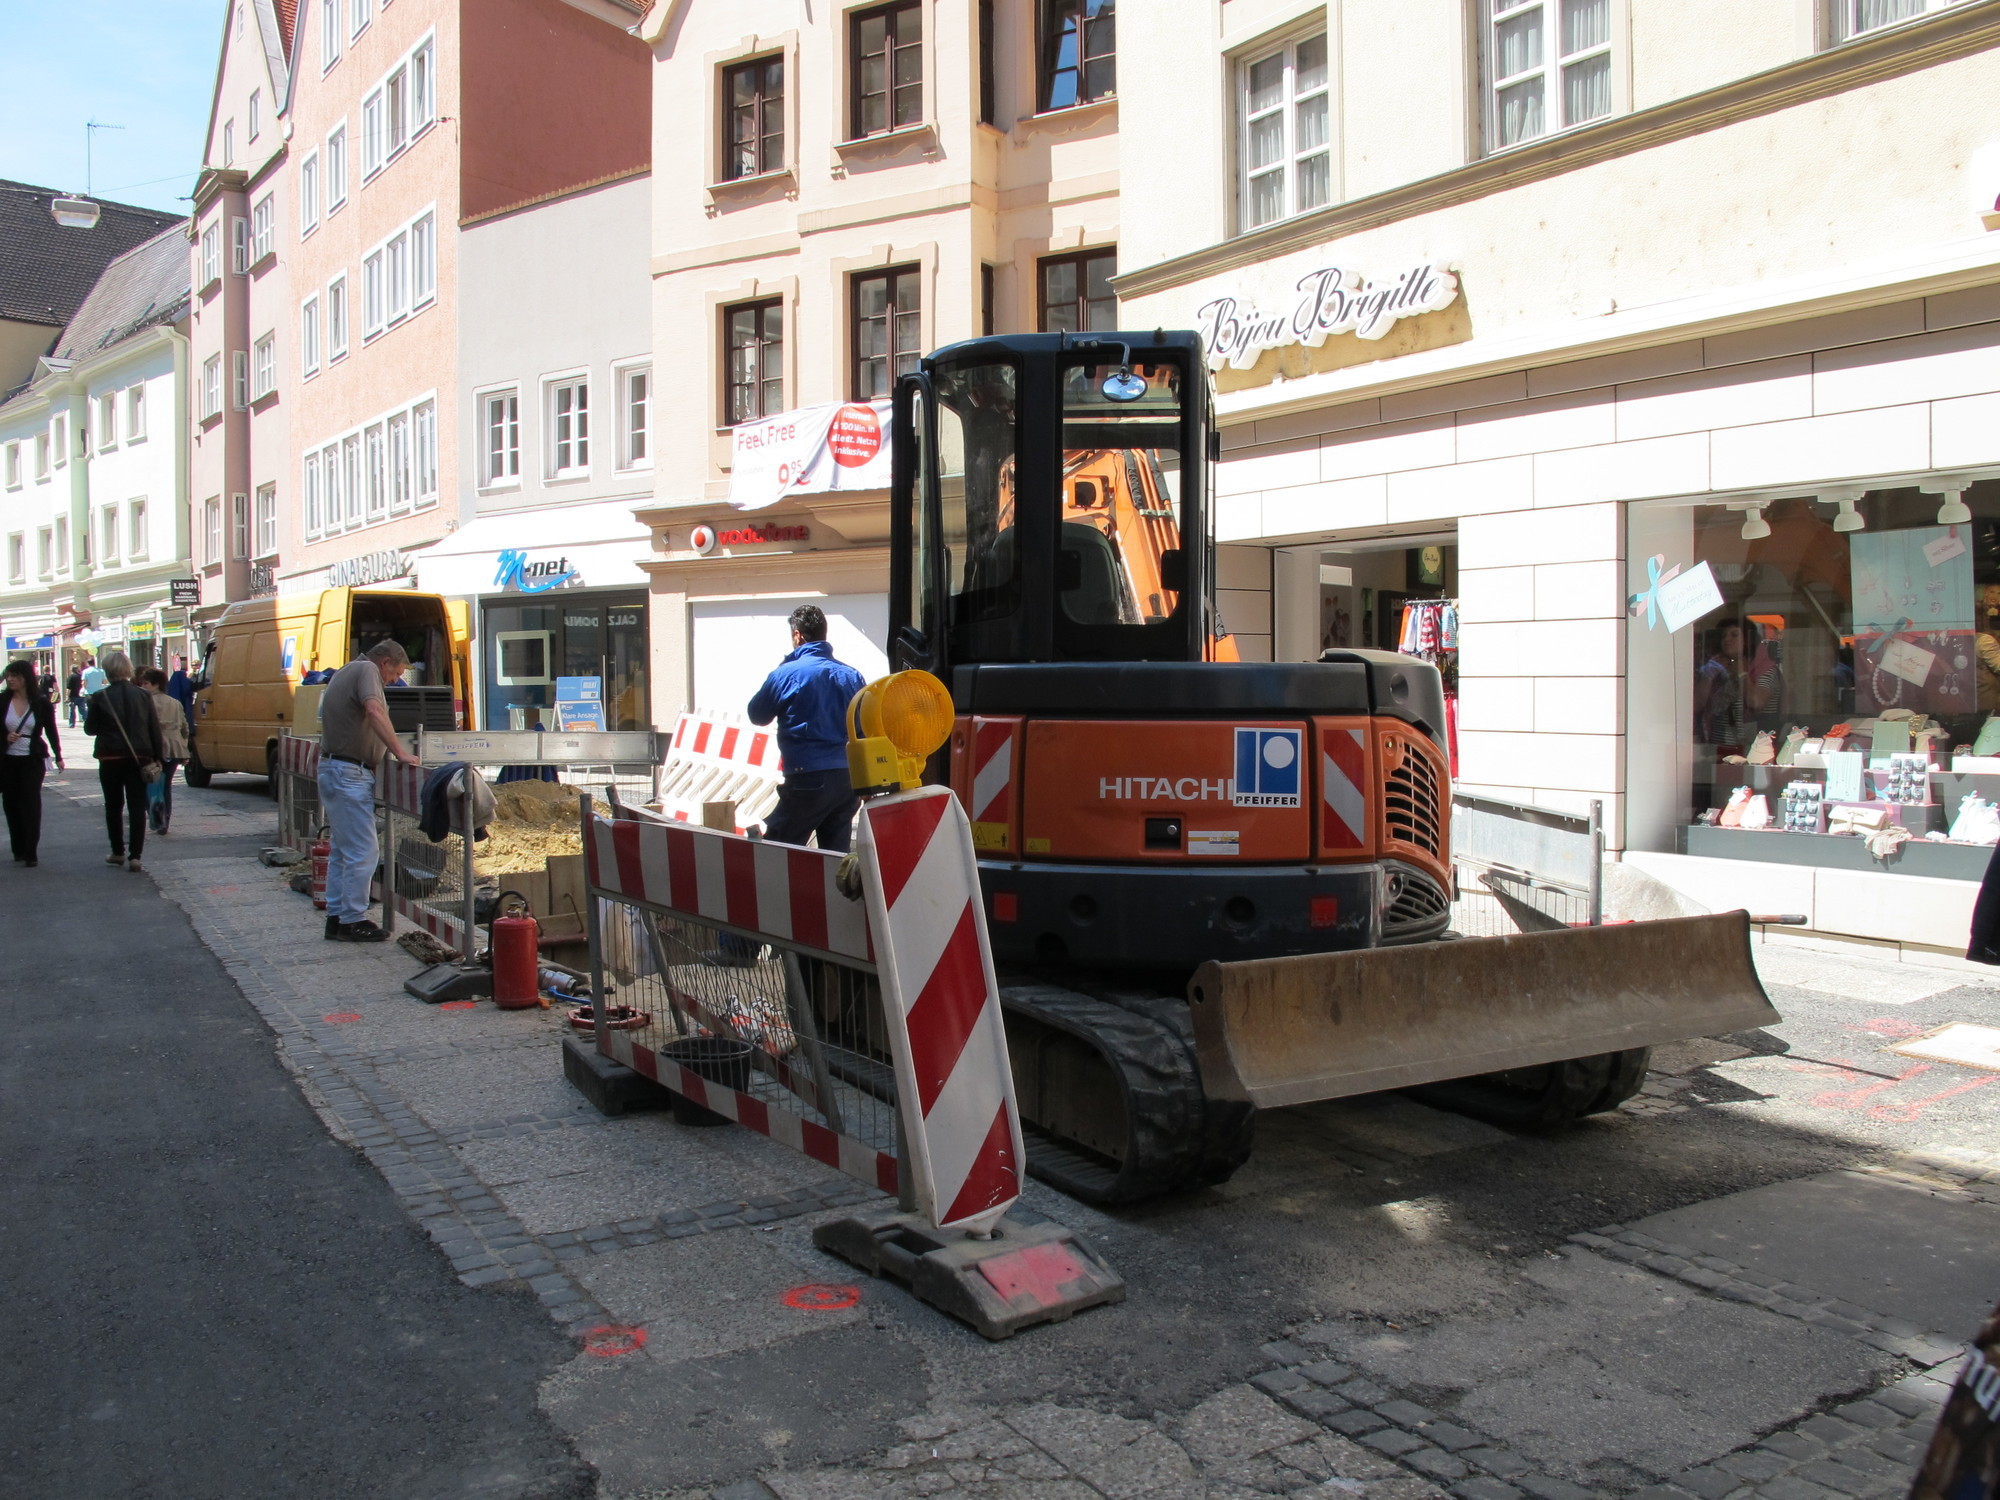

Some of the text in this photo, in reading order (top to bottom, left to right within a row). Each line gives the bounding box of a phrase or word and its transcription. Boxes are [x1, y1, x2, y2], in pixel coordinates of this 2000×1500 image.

[1197, 265, 1442, 363] Bijou Brigitte
[840, 422, 854, 431] 100
[738, 423, 796, 451] Feel Free
[856, 436, 878, 446] Netze
[717, 522, 809, 546] vodafone
[493, 548, 577, 594] M-net
[173, 582, 198, 590] LUSH
[876, 756, 888, 764] HKL
[1100, 777, 1234, 800] HITACHI
[1235, 796, 1298, 805] PFEIFFER
